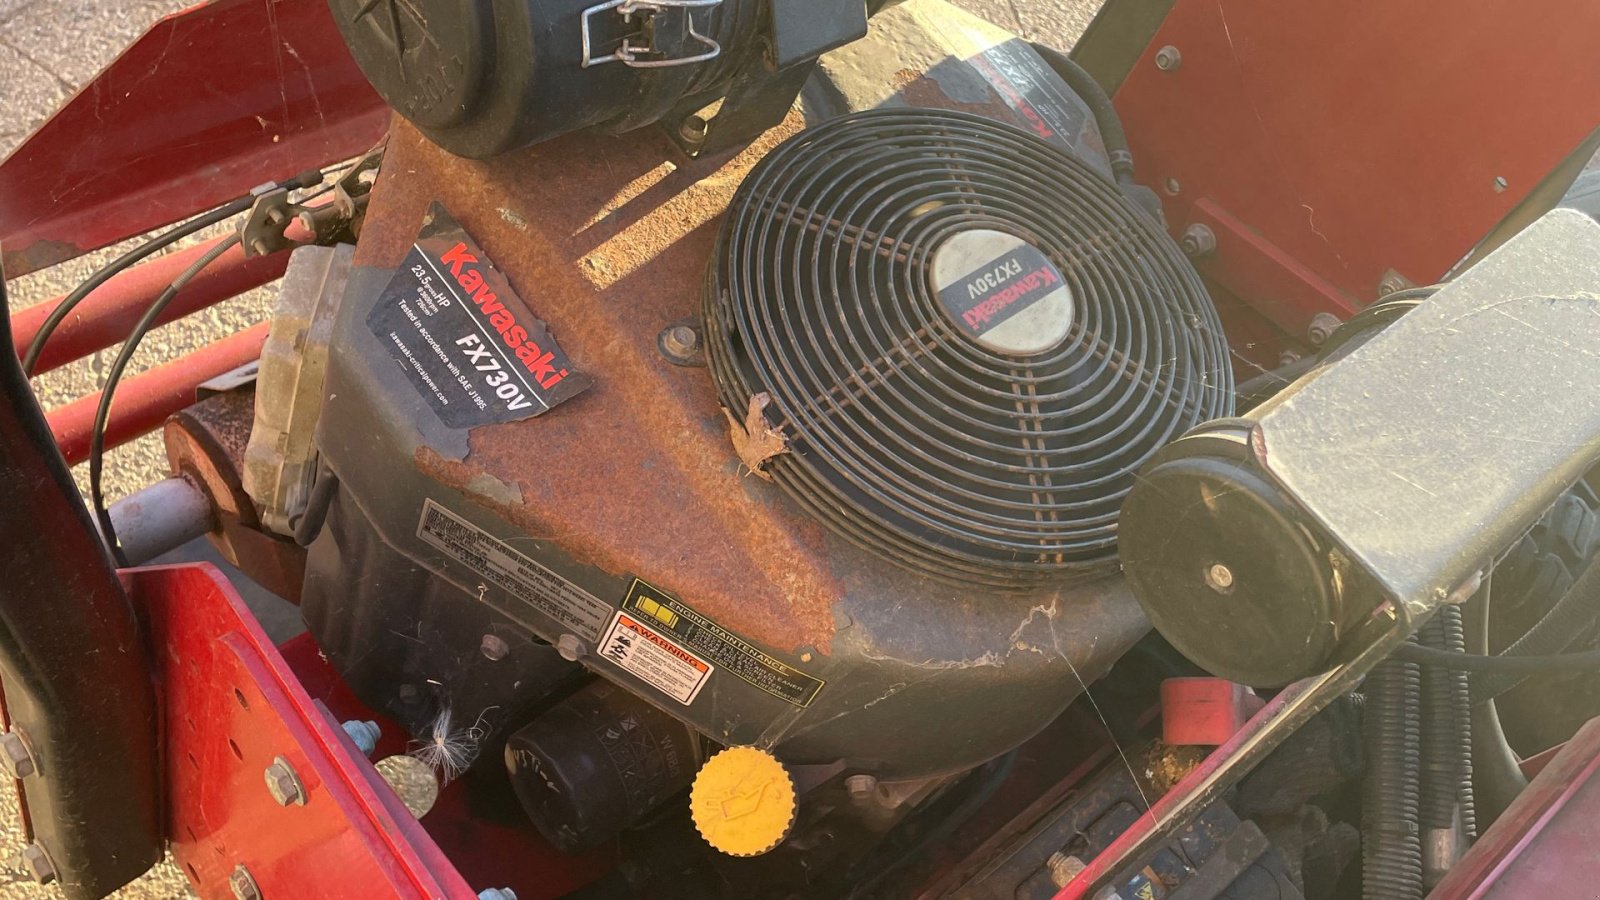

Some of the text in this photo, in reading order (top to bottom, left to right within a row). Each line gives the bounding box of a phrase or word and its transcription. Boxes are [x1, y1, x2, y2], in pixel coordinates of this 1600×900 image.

[961, 265, 1058, 331] Kawasaki
[967, 258, 1023, 299] FX730V
[440, 242, 569, 390] Kawasaki
[388, 330, 450, 406] kawasaki-criticalpower.com
[397, 298, 488, 411] Tested in accordance with SAE J1995.
[456, 333, 532, 411] FX730V
[639, 628, 699, 667] WARNING
[668, 601, 708, 627] ENGINE
[708, 625, 787, 672] MAINTENANCE
[767, 671, 803, 691] CLEANER
